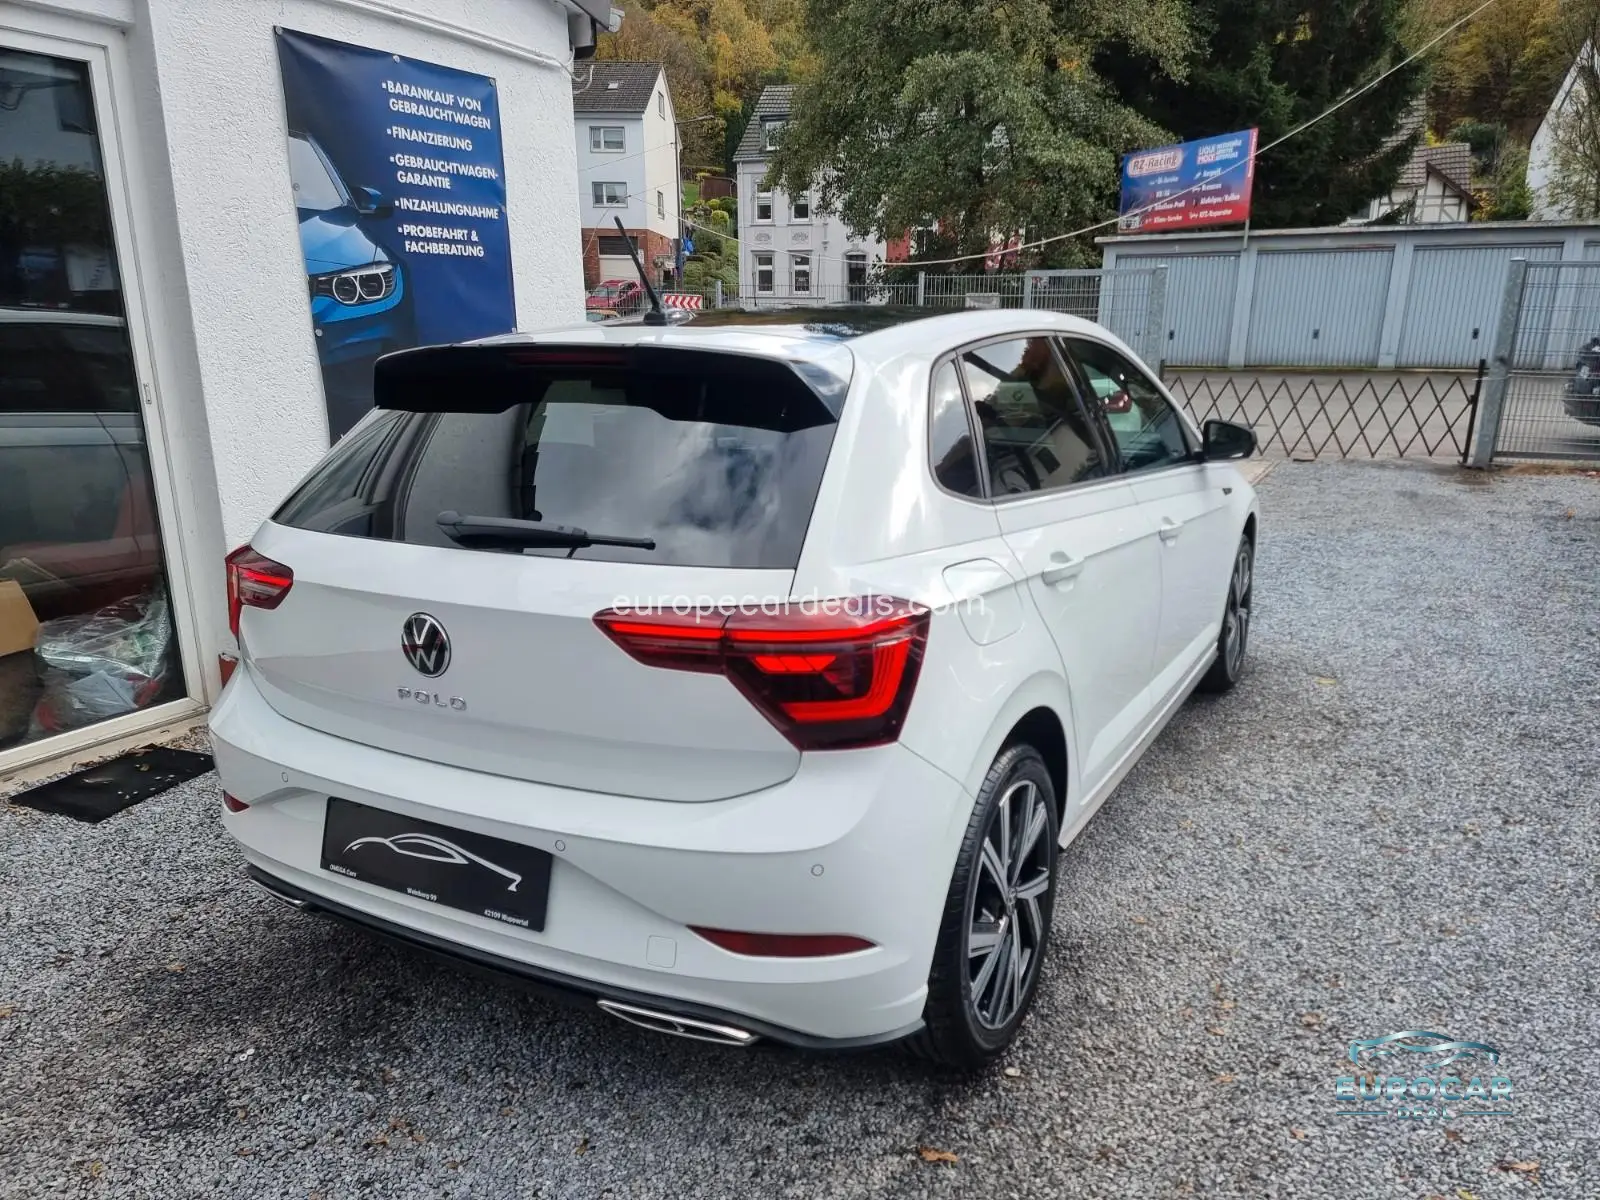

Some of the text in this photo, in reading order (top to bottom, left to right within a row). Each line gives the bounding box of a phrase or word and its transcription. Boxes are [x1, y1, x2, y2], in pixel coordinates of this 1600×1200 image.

[387, 80, 481, 112] BARANKAUF VON
[389, 98, 491, 129] GEBRAUCHTWAGEN
[392, 126, 473, 151] FINANZIERUNG
[395, 153, 499, 180] GEBRAUCHTWAGEN-
[1132, 153, 1178, 170] RZ-Racing
[397, 171, 451, 189] GARANTIE
[400, 197, 500, 220] INZAHLUNGNAHME
[403, 223, 479, 242] PROBEFAHRT &
[405, 240, 484, 258] FACHBERATUNG
[397, 687, 467, 711] POLO
[484, 909, 501, 919] 42109
